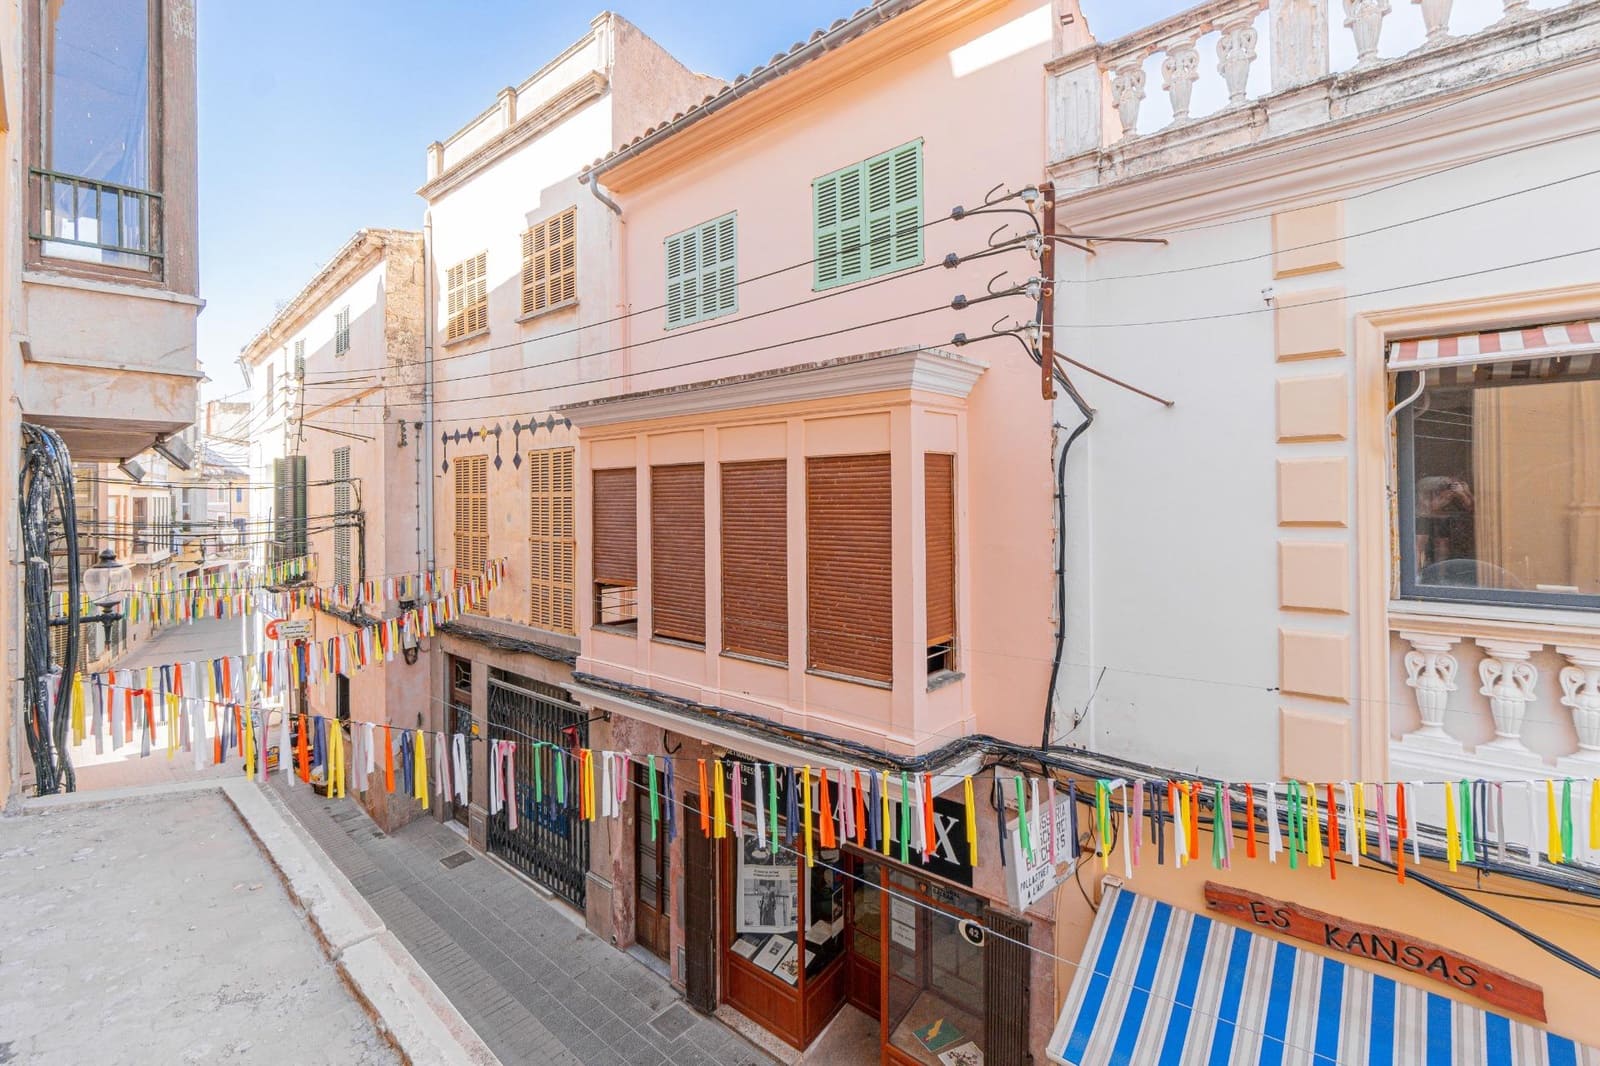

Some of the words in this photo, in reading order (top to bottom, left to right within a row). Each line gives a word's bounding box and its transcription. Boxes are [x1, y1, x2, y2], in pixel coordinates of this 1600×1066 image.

[726, 771, 748, 786] LOLS
[968, 927, 979, 939] 42
[1250, 901, 1291, 929] ES
[1323, 924, 1481, 988] KANSAS
